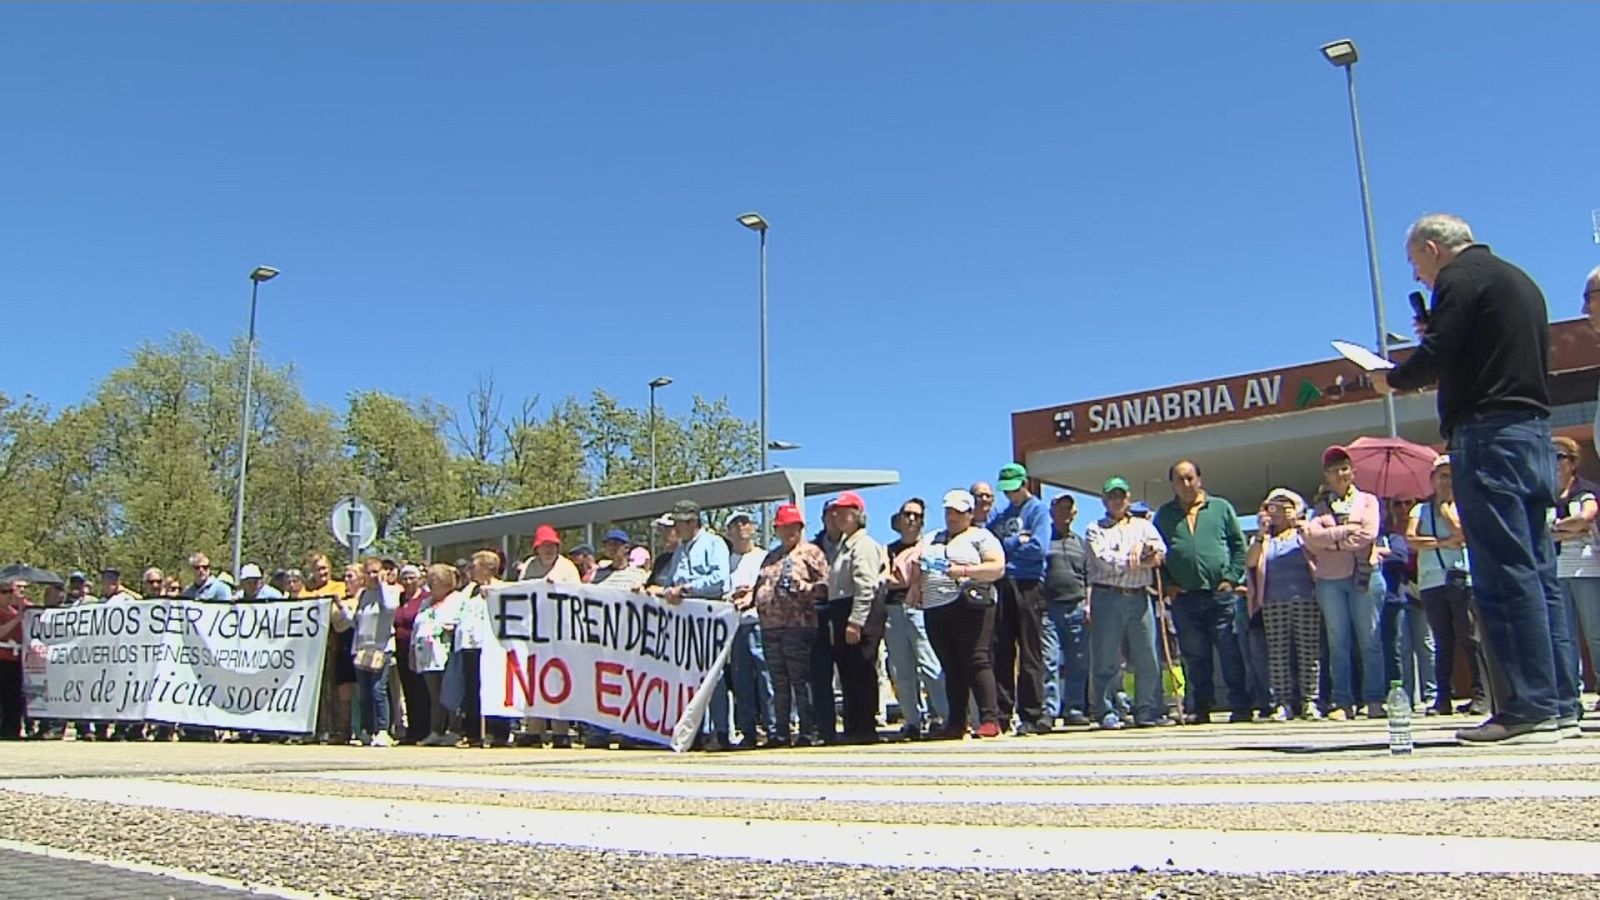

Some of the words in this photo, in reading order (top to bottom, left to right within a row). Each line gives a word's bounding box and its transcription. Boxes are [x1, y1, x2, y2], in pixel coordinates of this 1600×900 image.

[1088, 384, 1235, 433] SANABRIA
[1243, 374, 1282, 409] AV
[30, 605, 141, 640] QUEREMOS
[148, 604, 203, 636] SER
[208, 606, 320, 639] IGUALES
[495, 592, 550, 643] EL
[547, 592, 622, 650] TREN
[50, 644, 110, 665] DEVOLVER
[111, 644, 138, 664] LOS
[503, 648, 573, 708] NO
[90, 668, 116, 703] de
[221, 674, 305, 713] social
